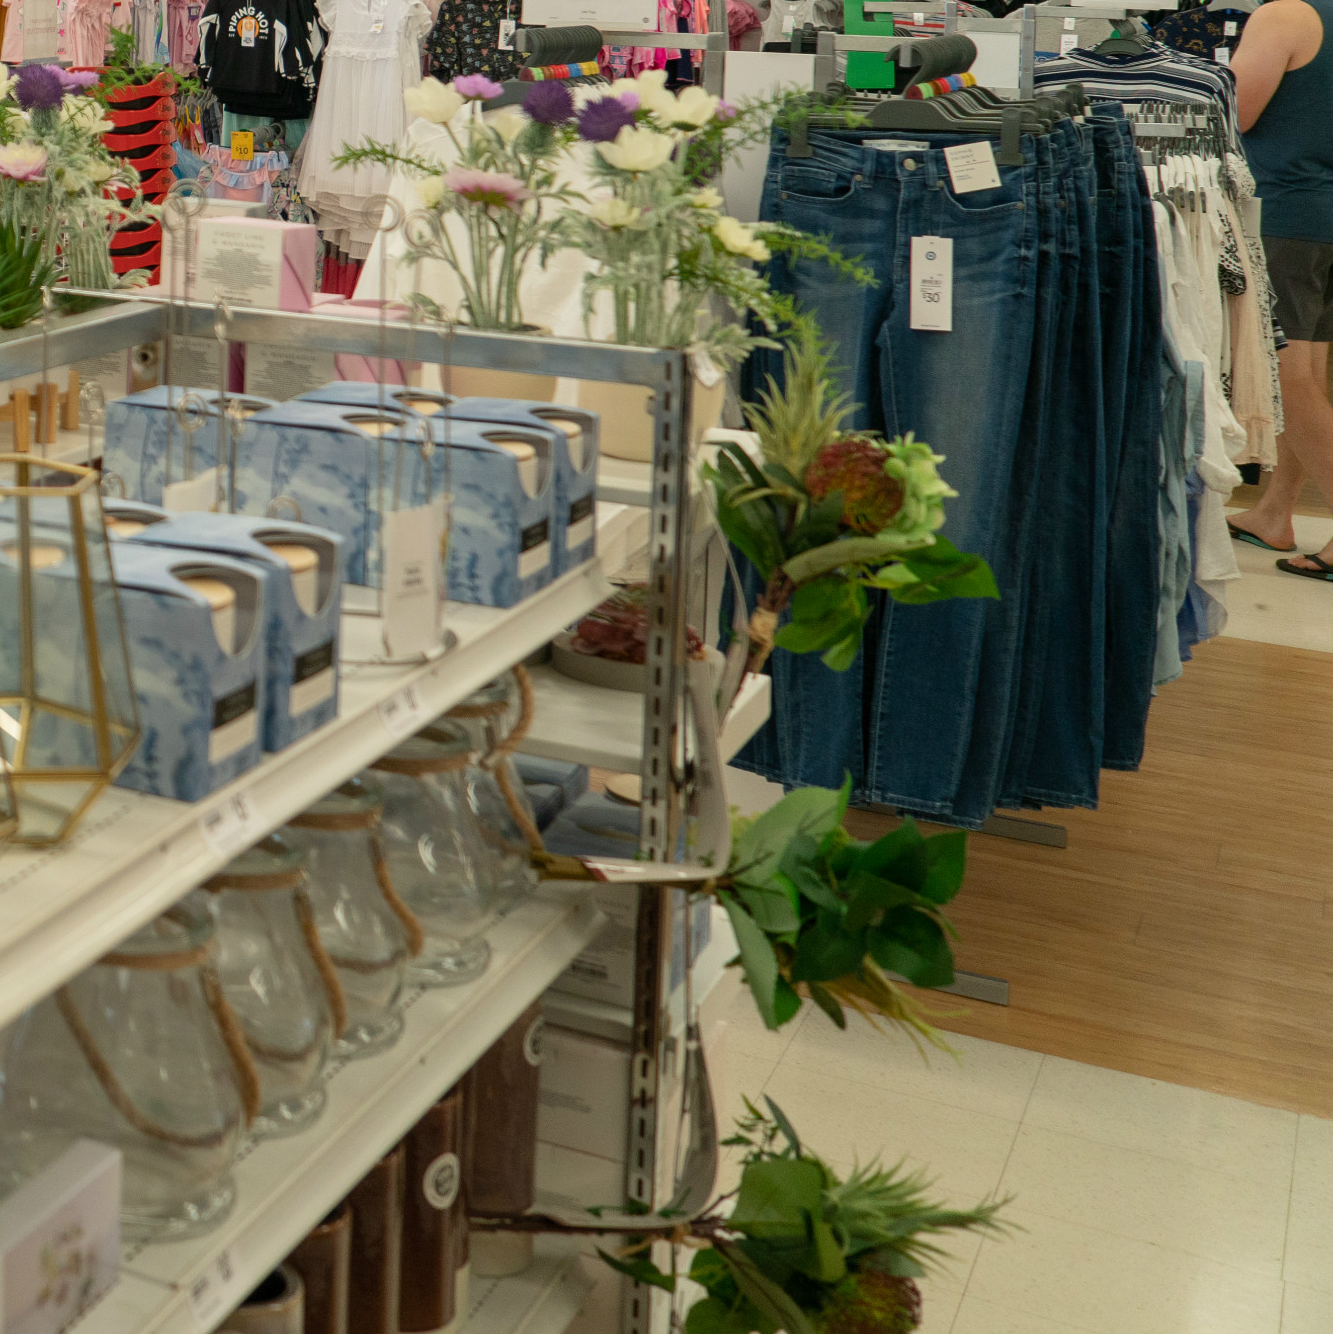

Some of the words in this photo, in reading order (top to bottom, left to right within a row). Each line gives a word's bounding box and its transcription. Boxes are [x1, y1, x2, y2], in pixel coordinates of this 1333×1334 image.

[229, 6, 255, 33] PIPING
[255, 7, 269, 35] HOT
[922, 292, 940, 303] $30
